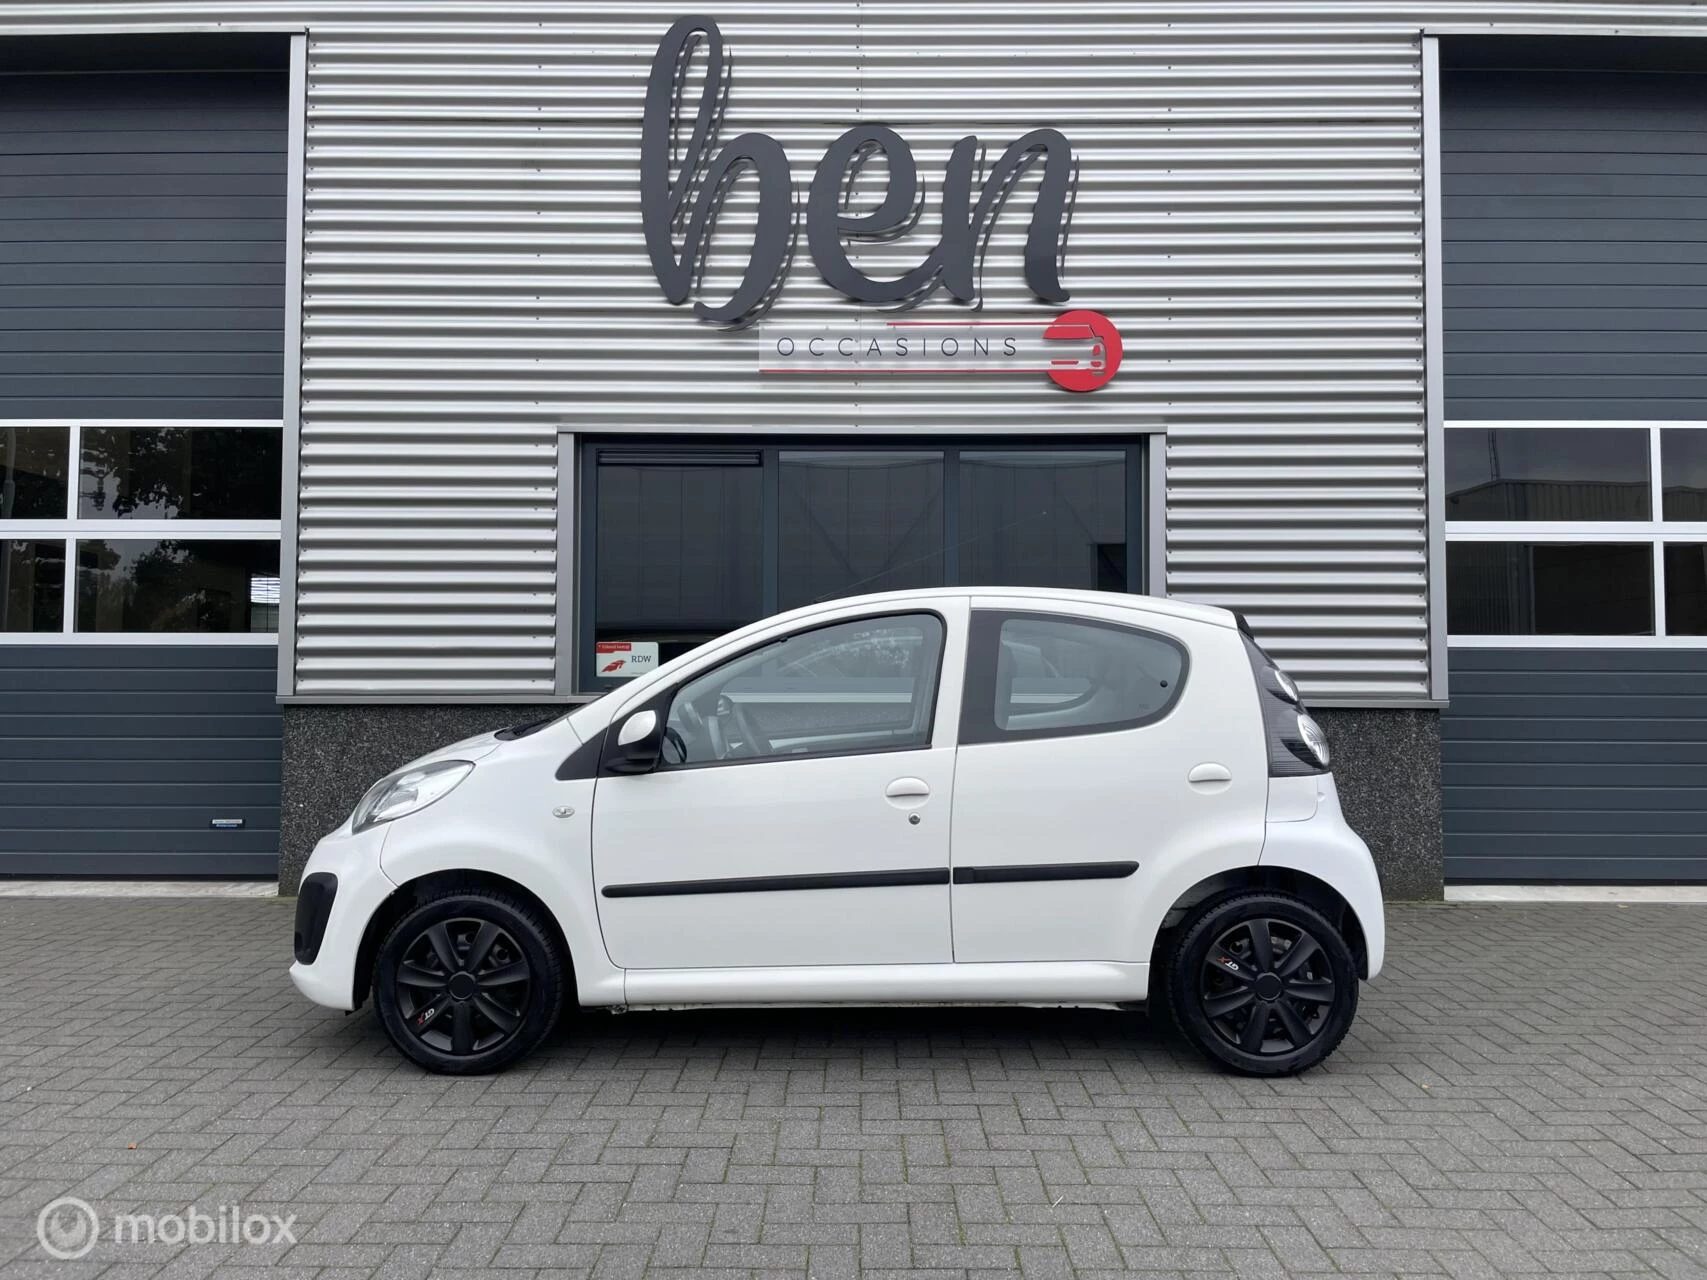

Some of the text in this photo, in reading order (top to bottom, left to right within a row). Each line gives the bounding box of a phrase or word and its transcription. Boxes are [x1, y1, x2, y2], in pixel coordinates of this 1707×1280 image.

[640, 15, 1070, 321] ben
[776, 337, 1017, 357] OCCASIONS
[631, 655, 652, 663] RDW
